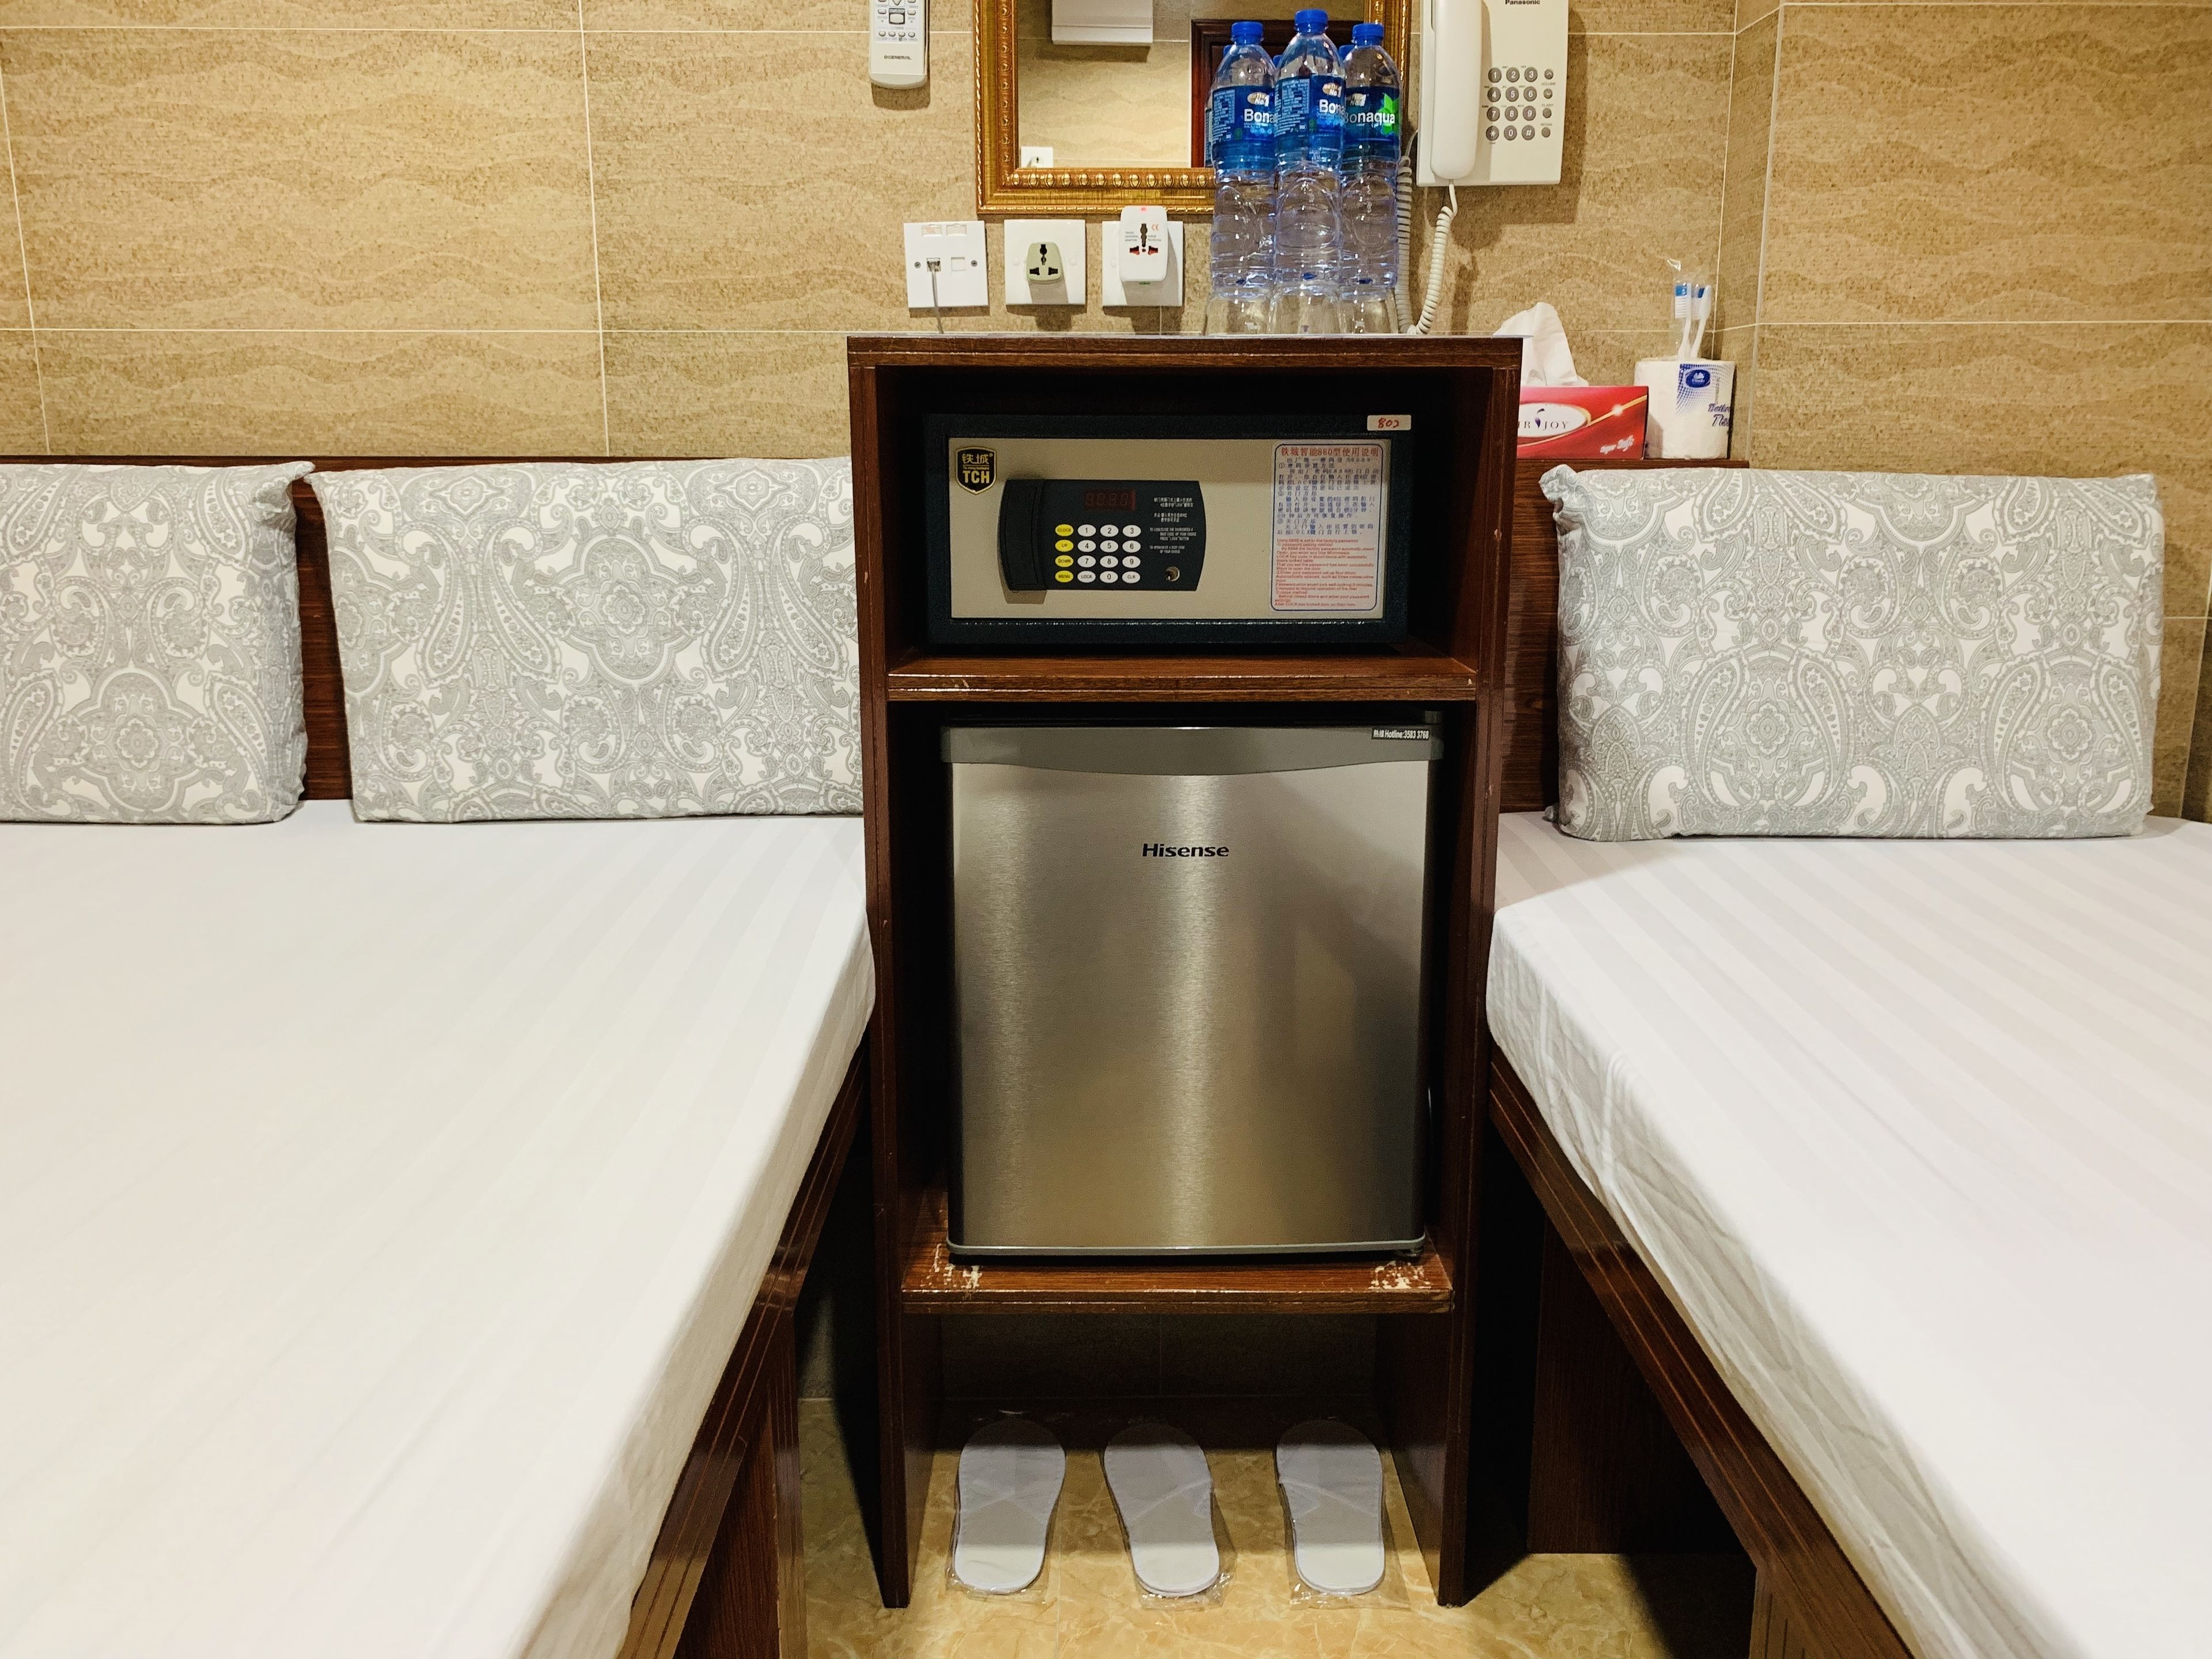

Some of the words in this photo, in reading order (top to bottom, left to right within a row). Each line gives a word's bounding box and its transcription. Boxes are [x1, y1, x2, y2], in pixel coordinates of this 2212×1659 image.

[1319, 99, 1346, 114] Bona
[1244, 109, 1275, 123] Bona
[1543, 421, 1568, 430] JOY
[963, 470, 990, 483] TCH
[1416, 730, 1429, 739] 3768
[1142, 843, 1229, 857] Hisense
